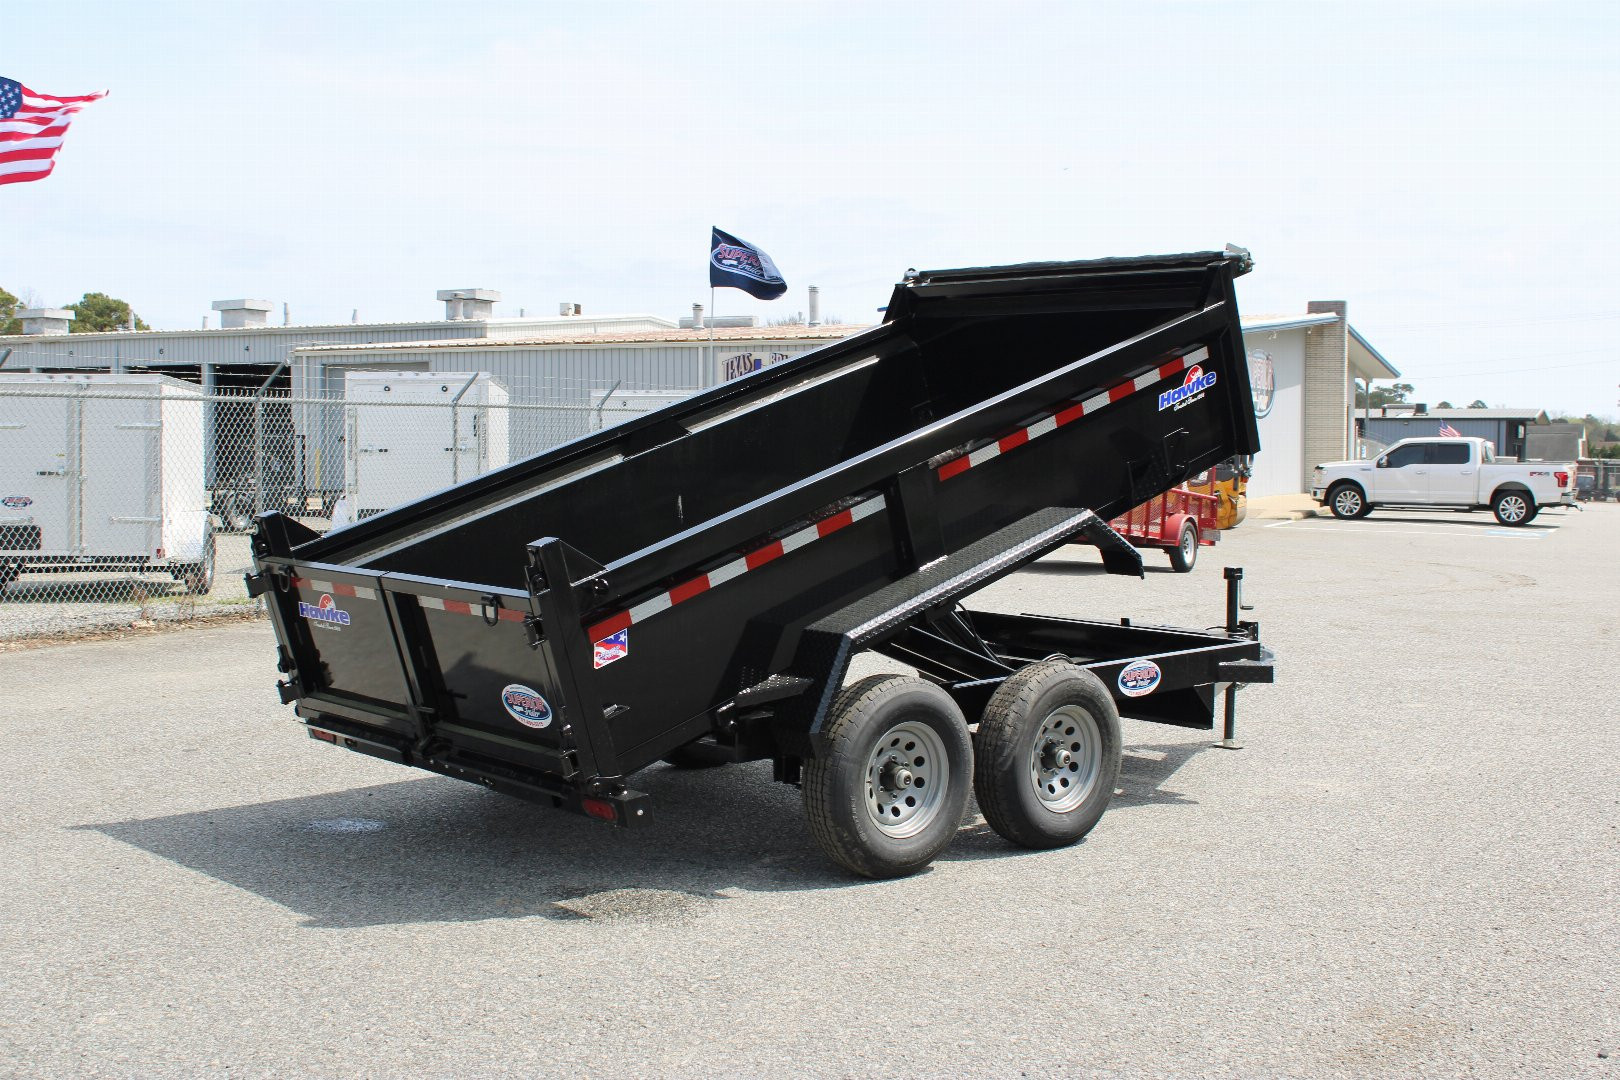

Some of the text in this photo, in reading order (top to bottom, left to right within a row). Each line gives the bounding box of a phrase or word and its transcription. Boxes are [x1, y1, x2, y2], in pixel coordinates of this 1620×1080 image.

[722, 352, 752, 381] TEXAS
[1158, 371, 1217, 412] Hawke
[298, 601, 351, 626] Hawke
[1122, 667, 1156, 682] SUPERIOR
[505, 690, 546, 712] SUPERIOR
